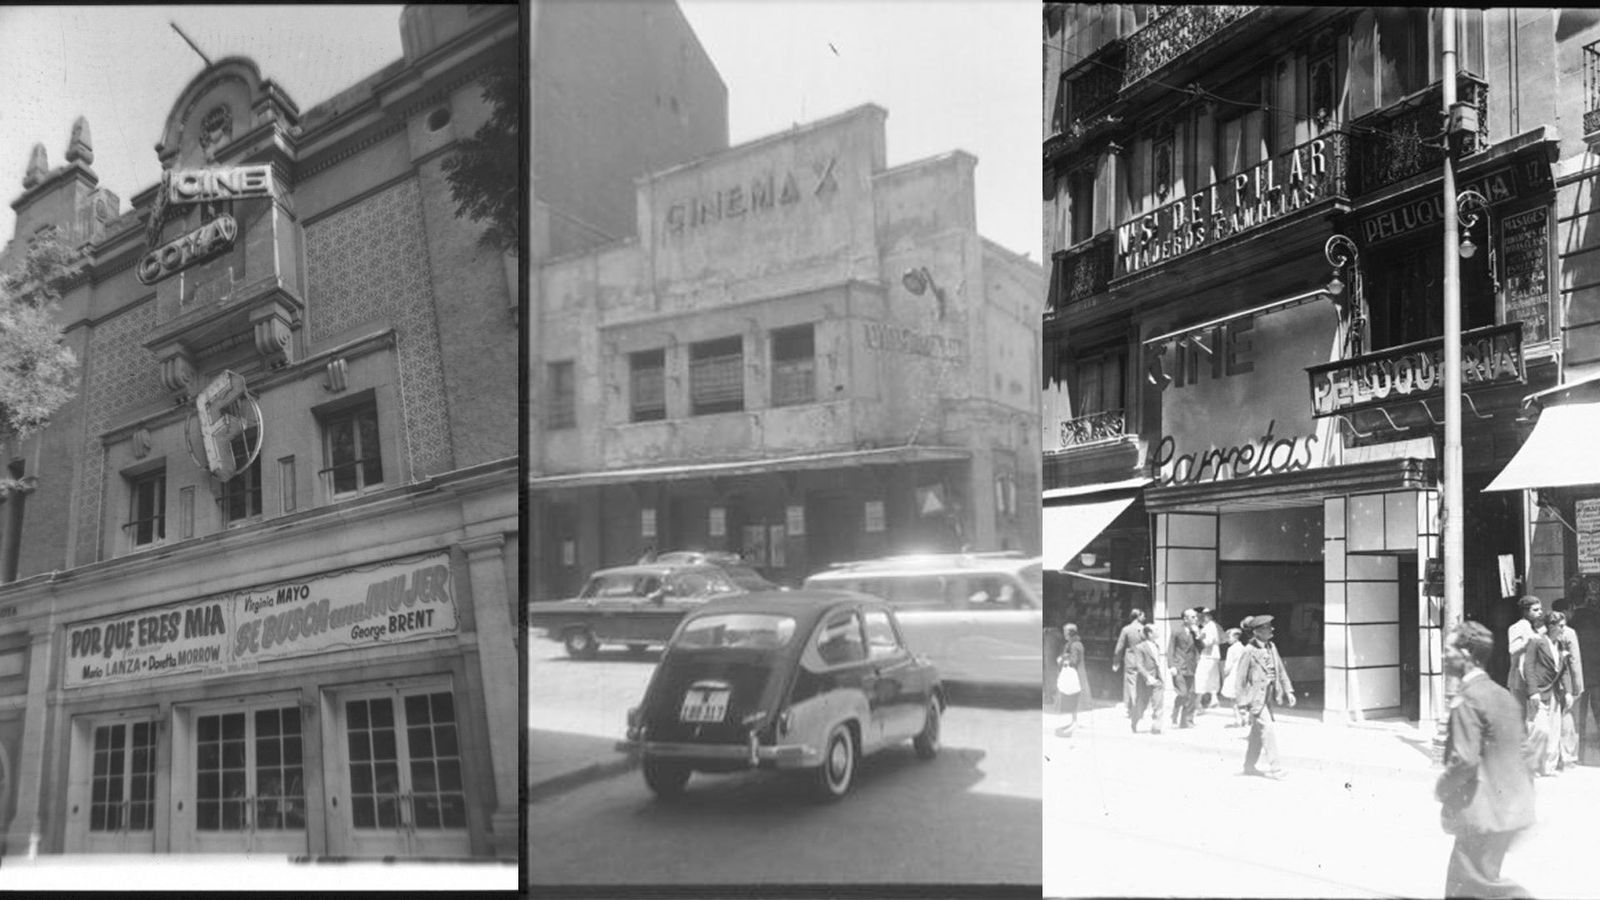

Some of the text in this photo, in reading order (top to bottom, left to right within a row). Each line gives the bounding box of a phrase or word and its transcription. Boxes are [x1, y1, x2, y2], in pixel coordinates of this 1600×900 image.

[177, 170, 269, 198] CINE
[667, 170, 802, 238] CINEMA
[1173, 185, 1223, 230] DEL
[1236, 139, 1326, 207] PILAR
[1364, 175, 1510, 244] PELUQURIA
[138, 215, 236, 282] GOYA
[1125, 183, 1315, 273] VIAJEROS FAMILIAS
[1511, 285, 1543, 301] SALON
[1152, 420, 1319, 487] Carretas
[72, 604, 226, 658] POR QUE ERES MIA
[235, 619, 262, 657] SE
[261, 599, 330, 649] BUSCA
[364, 564, 450, 620] MUJER
[244, 585, 310, 614] Virginia MAYO
[351, 609, 435, 640] George BRENT
[82, 646, 221, 680] Mario LANZA Doretta MORROW
